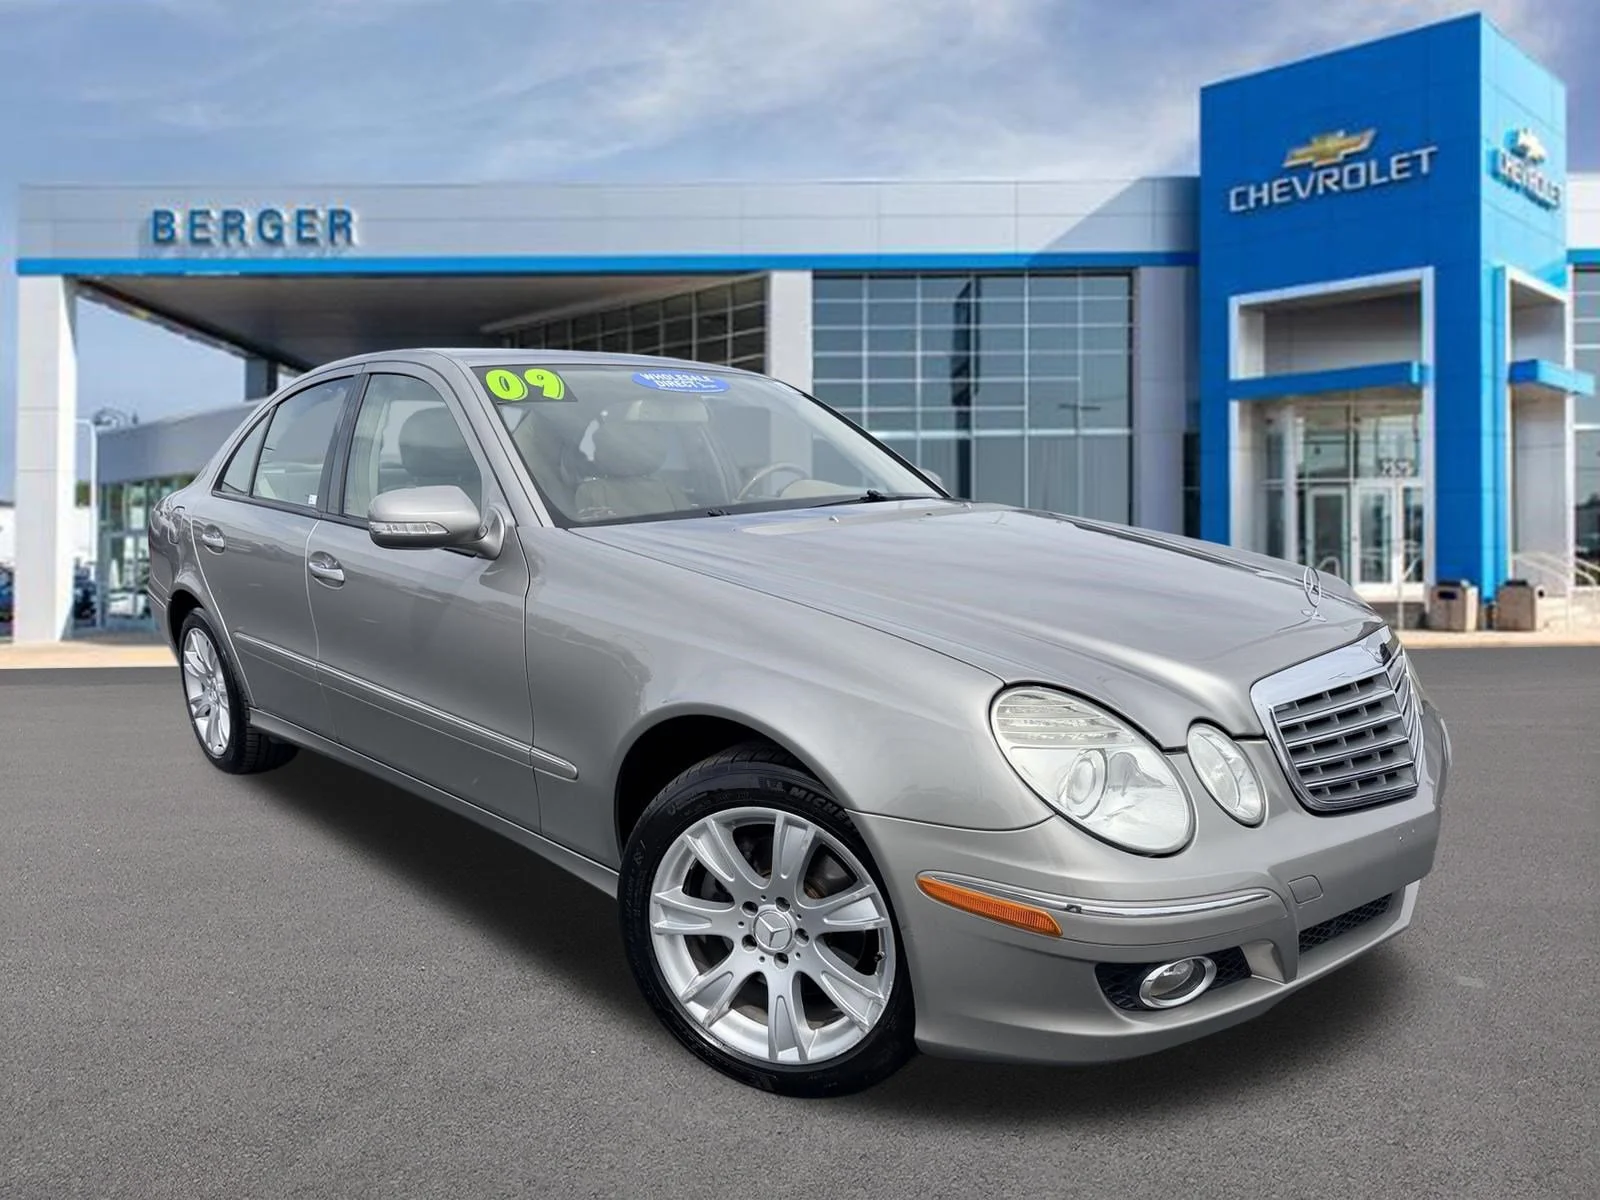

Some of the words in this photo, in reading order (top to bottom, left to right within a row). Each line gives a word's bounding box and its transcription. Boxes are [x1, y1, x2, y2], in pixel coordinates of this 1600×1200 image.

[1229, 146, 1438, 213] CHEVROLET
[152, 208, 356, 247] BERGER
[485, 368, 566, 402] 09
